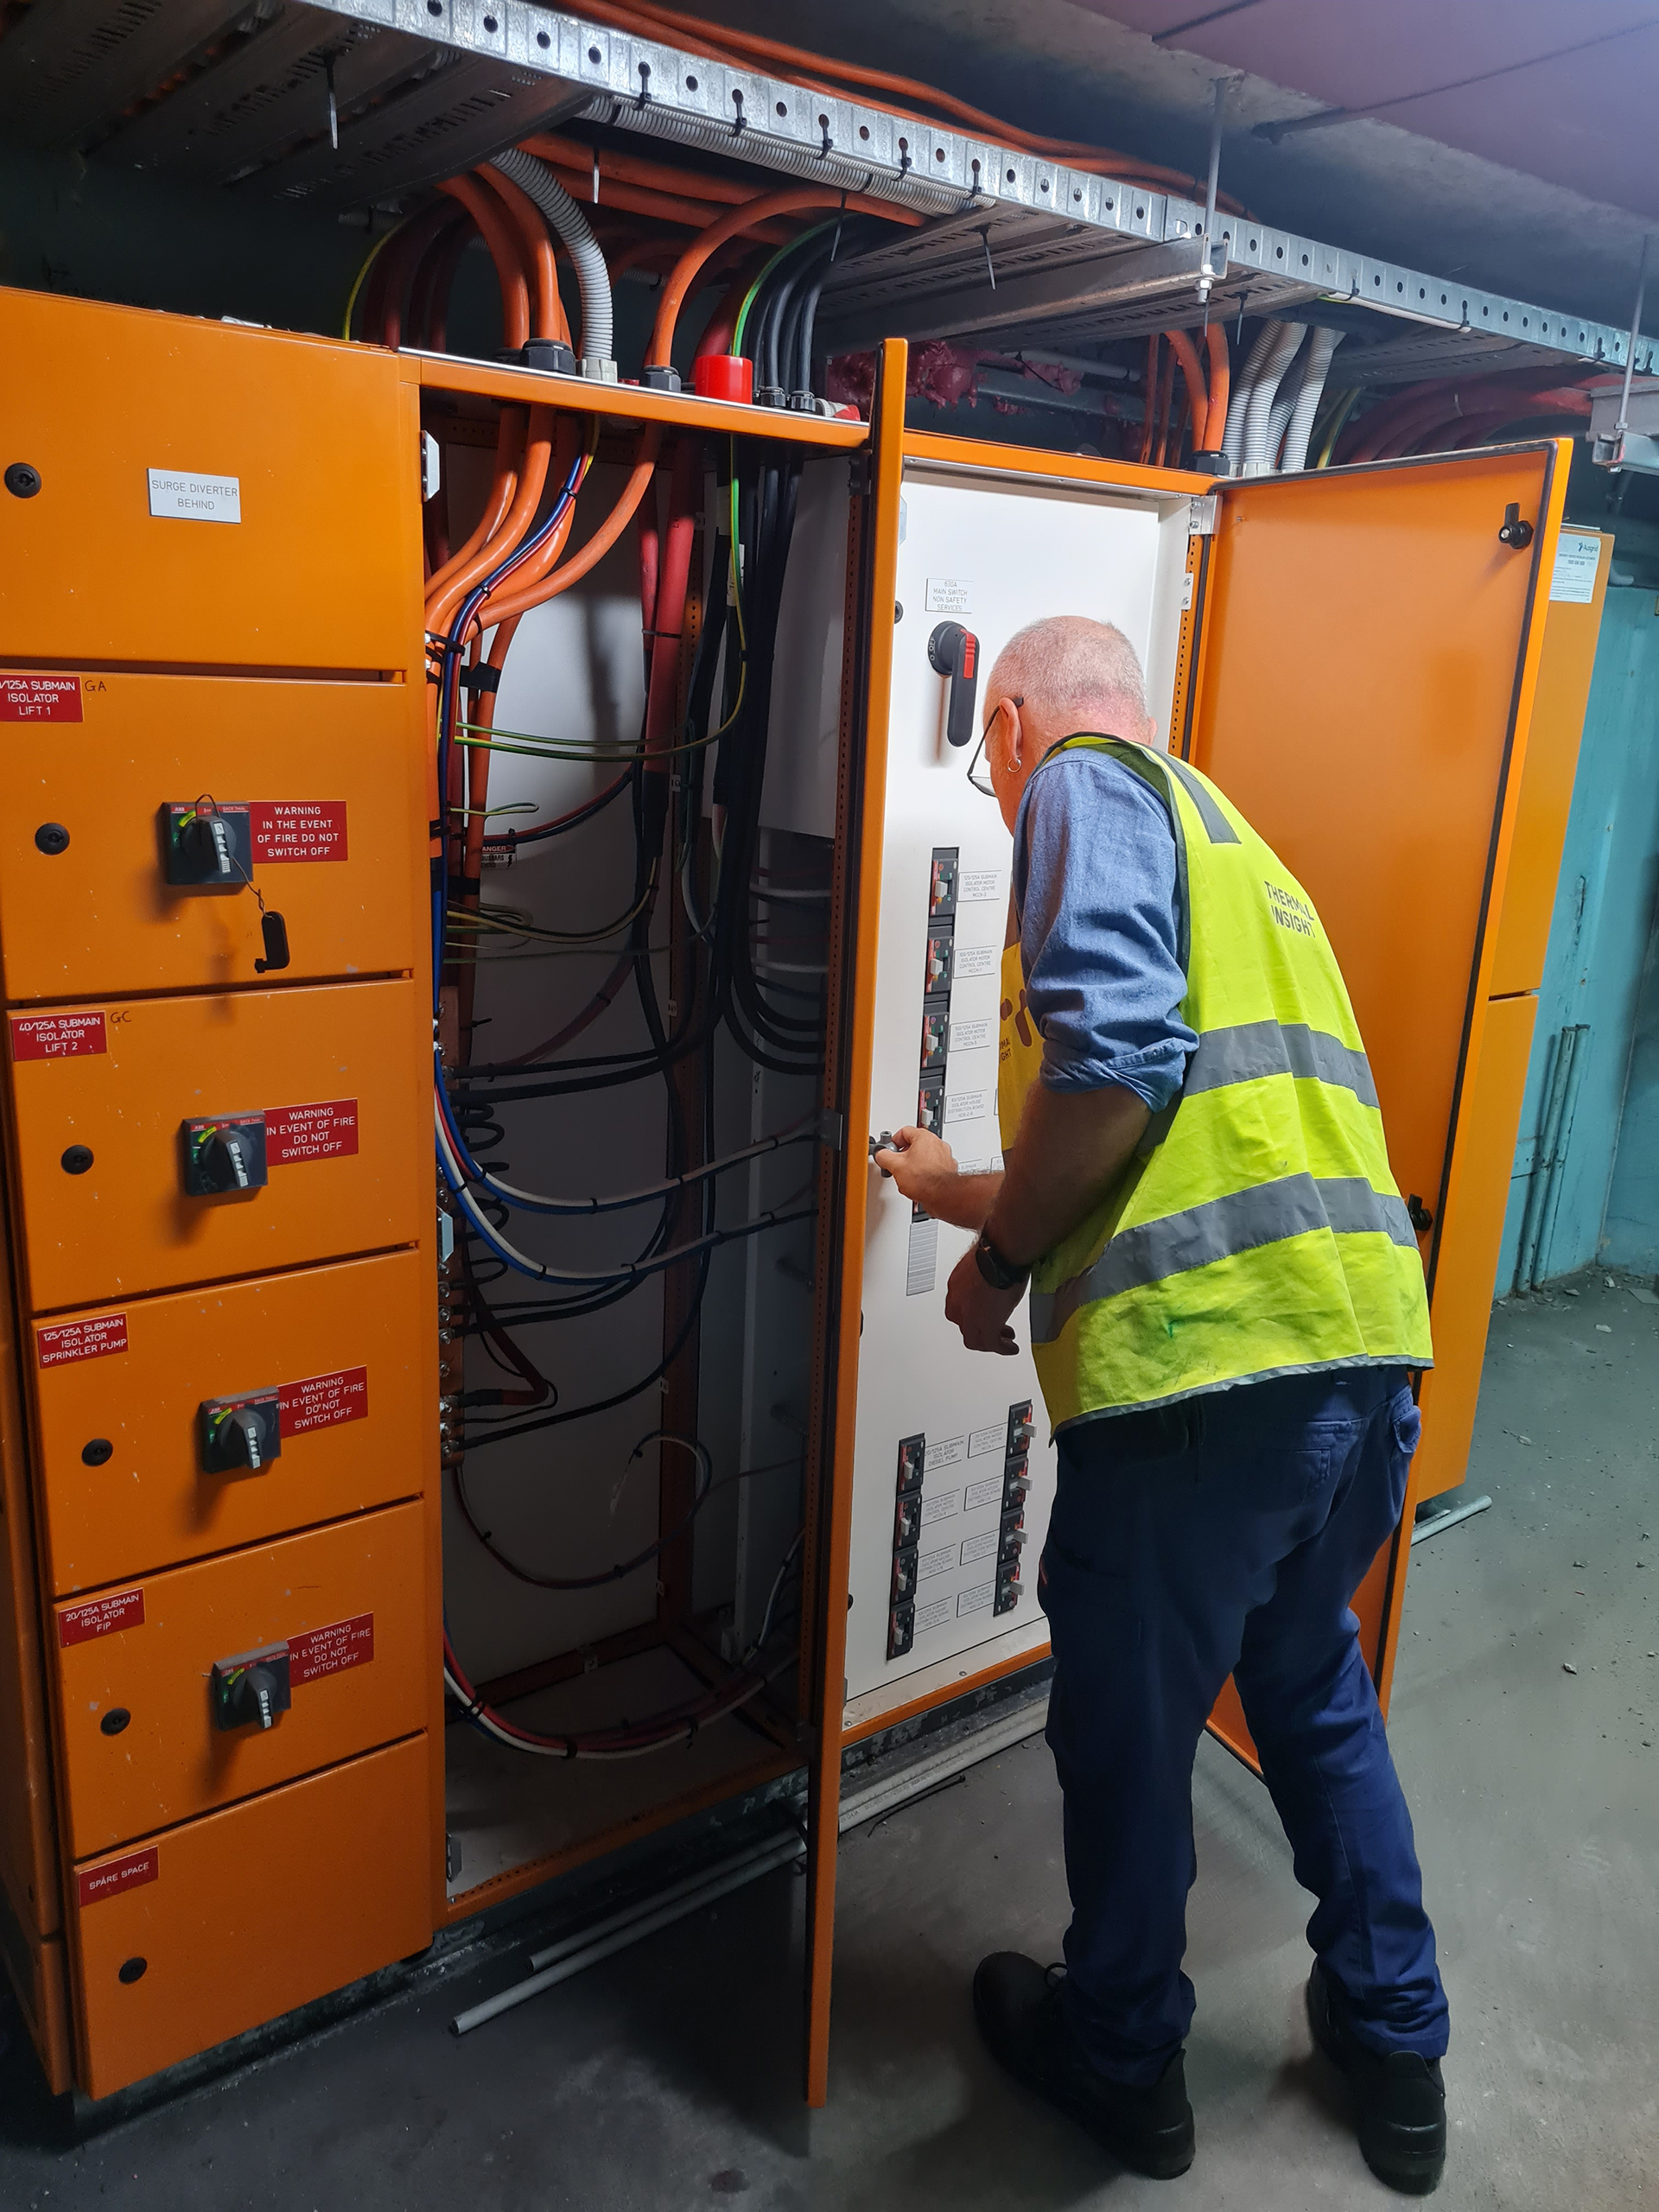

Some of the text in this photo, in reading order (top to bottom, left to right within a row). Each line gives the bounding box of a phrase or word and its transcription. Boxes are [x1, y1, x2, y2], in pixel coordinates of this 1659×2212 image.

[152, 480, 238, 497] SURGE DIVERTER
[177, 498, 215, 510] BEHIND
[31, 681, 75, 691] SUBMAIN
[8, 693, 59, 703] ISOLATOR
[19, 706, 51, 715] LIFT 1
[274, 806, 321, 815] WARNING
[263, 819, 333, 830] IN THE EVENT
[257, 833, 339, 843] OF FIRE DO NOT
[268, 847, 331, 857] SWITCH OFF
[1270, 905, 1316, 938] INSIGHT
[19, 1017, 100, 1031] 40/125A SUBMAIN
[36, 1029, 85, 1042] ISOLATOR
[45, 1041, 78, 1052] LIFT 2
[289, 1107, 334, 1121] WARNING
[266, 1116, 355, 1135] IN EVENT OF FIRE
[294, 1131, 329, 1145] DO NOT
[282, 1141, 342, 1158] SWITCH OFF
[43, 1319, 124, 1341] 125/125A SUBMAIN
[61, 1332, 107, 1348] ISOLATOR
[42, 1338, 127, 1363] SPRINKLER PUMP
[301, 1376, 344, 1394] WARNING
[279, 1382, 365, 1410] IN EVENT OF FIRE
[305, 1398, 340, 1415] DO NOT
[295, 1407, 353, 1429] SWITCH OFF
[944, 1440, 964, 1450] SUBMAIN
[933, 1448, 954, 1459] ISOLATOR
[66, 1593, 139, 1622] 20/125A SUBMAIN
[81, 1608, 125, 1627] ISOLATOR
[97, 1621, 111, 1632] FIP
[310, 1624, 352, 1643] WARNING
[289, 1652, 299, 1662] IN
[302, 1640, 332, 1657] EVENT
[335, 1635, 347, 1646] OF
[351, 1628, 371, 1641] FIRE
[315, 1645, 347, 1664] DO NOT
[303, 1652, 359, 1678] SWITCH OFF
[89, 1861, 149, 1890] SPARE SPACE
